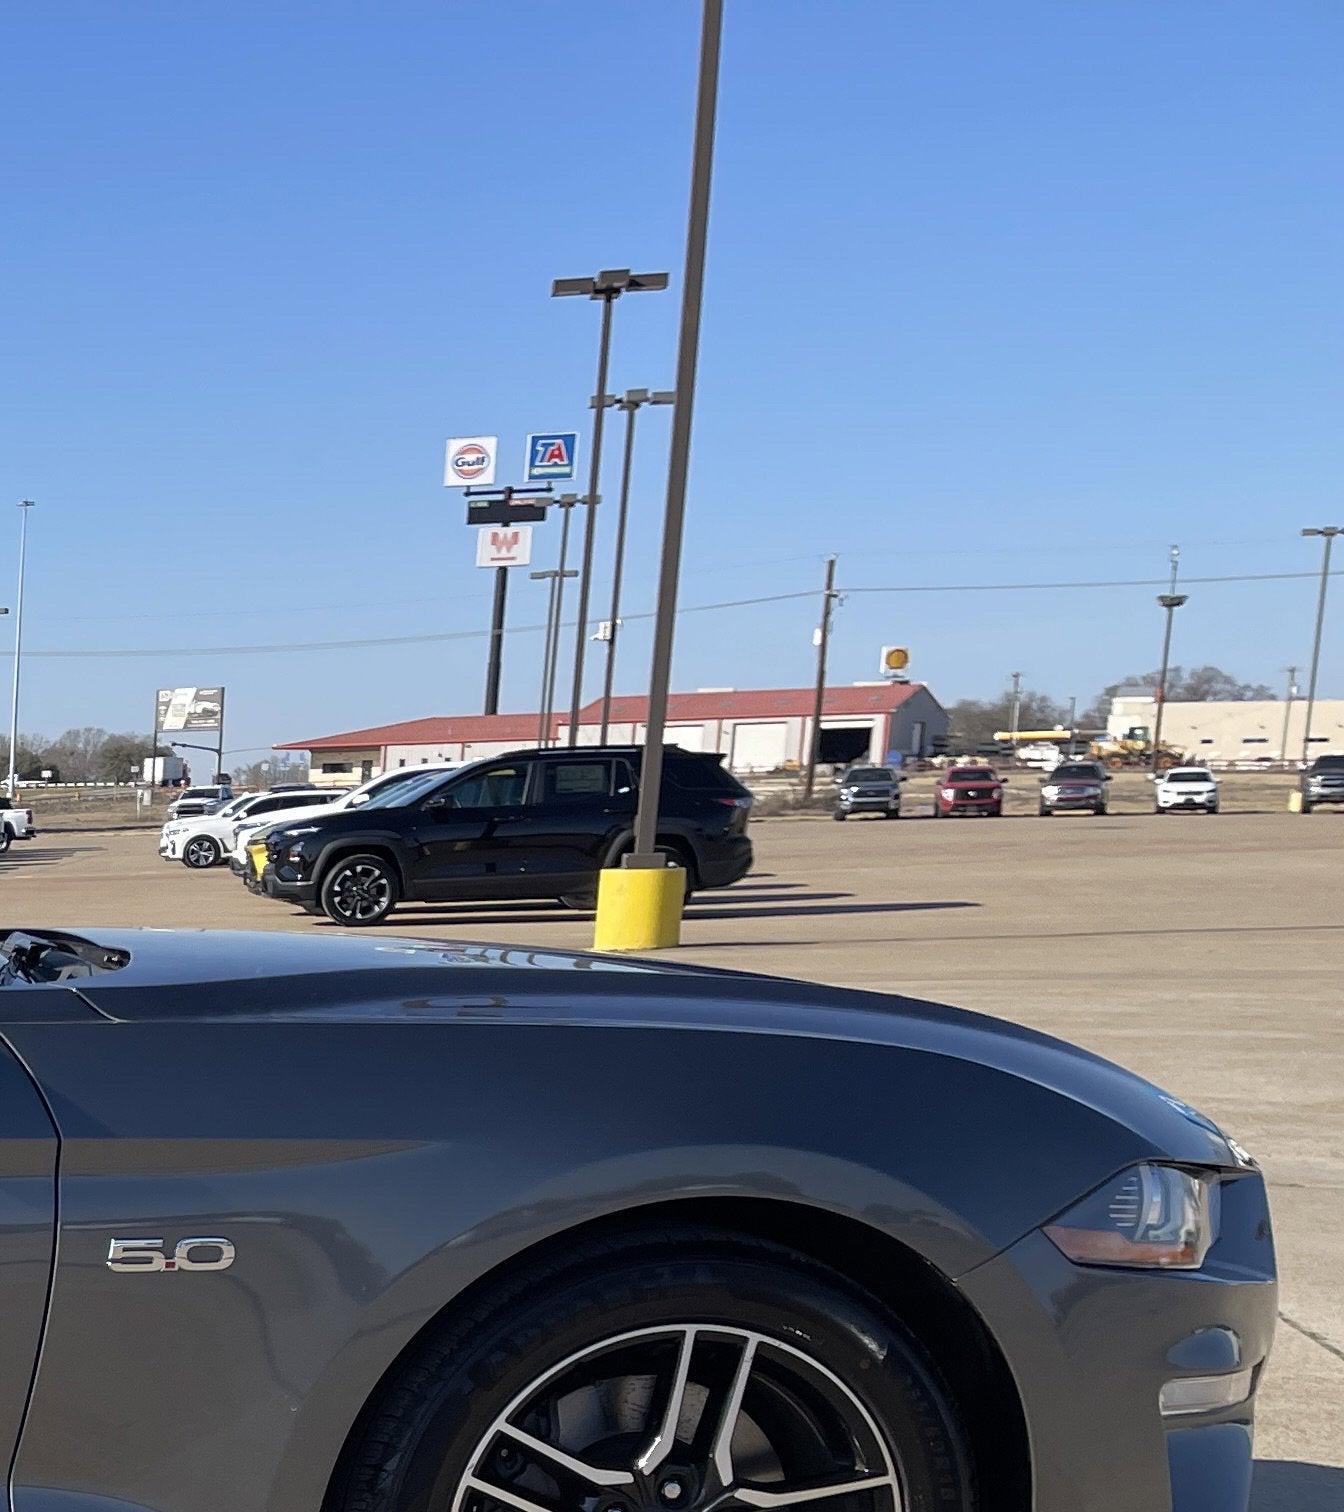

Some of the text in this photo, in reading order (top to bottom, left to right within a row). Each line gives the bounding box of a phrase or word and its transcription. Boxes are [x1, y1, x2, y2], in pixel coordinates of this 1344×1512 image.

[455, 456, 486, 467] Gulf
[535, 439, 569, 465] TA
[106, 1237, 235, 1273] 5.0
